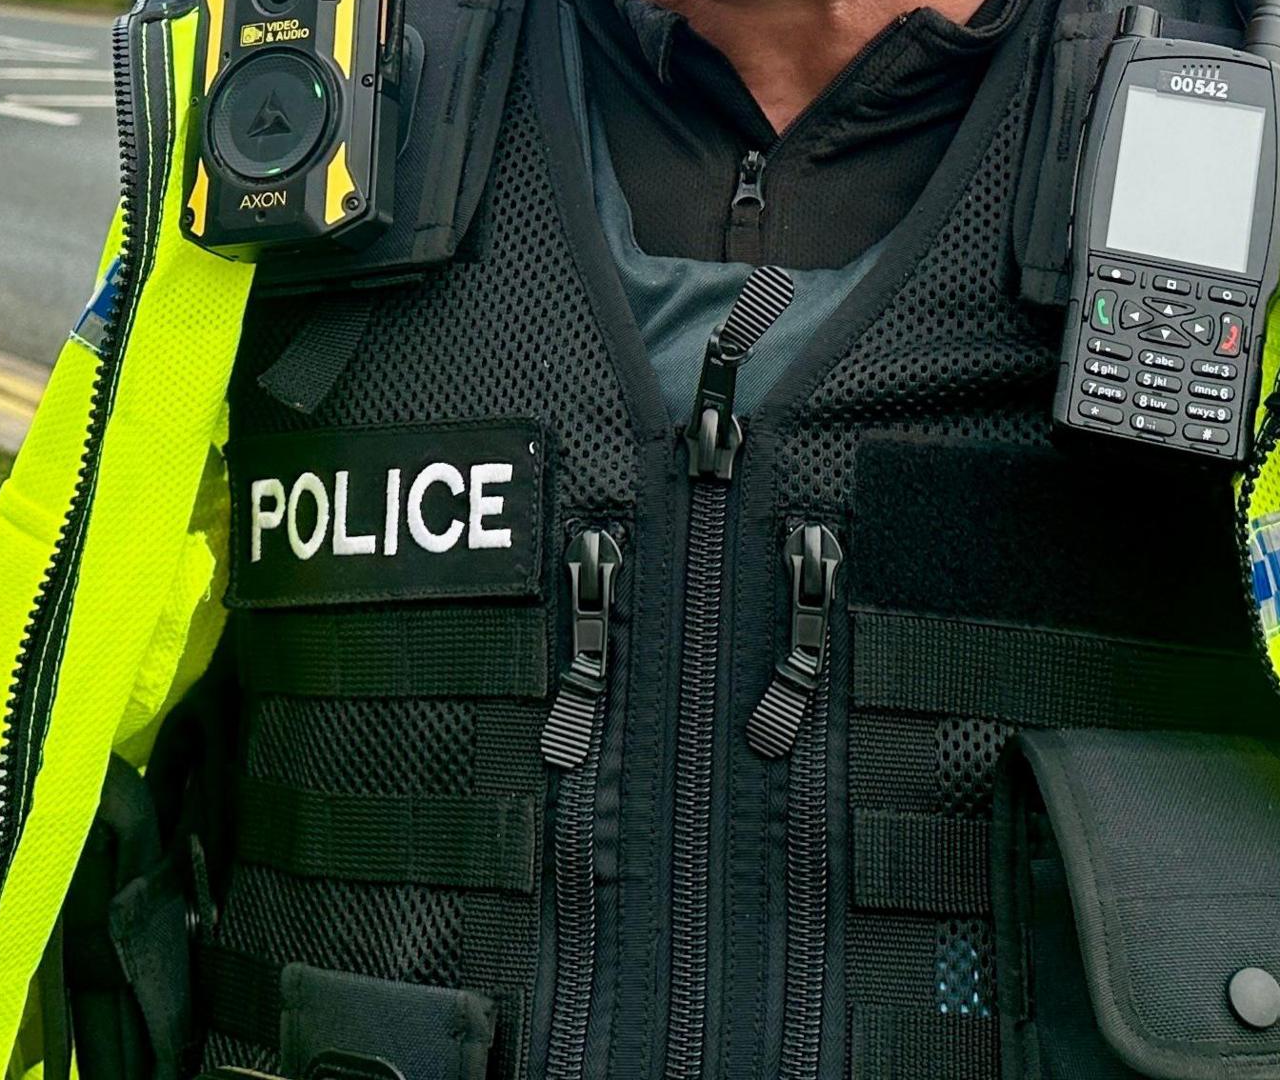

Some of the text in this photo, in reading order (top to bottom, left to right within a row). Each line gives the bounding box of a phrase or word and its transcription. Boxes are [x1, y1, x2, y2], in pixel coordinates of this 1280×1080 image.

[266, 19, 299, 32] VIDEO
[265, 27, 310, 42] & AUDIO
[1170, 75, 1229, 99] 00542
[239, 190, 287, 210] AXON
[1094, 340, 1102, 352] 1
[1145, 353, 1175, 367] 2 abc
[1090, 361, 1119, 376] 4 ghi
[1220, 365, 1230, 377] 3
[1142, 374, 1168, 388] 5 jkl
[1087, 382, 1122, 399] 7 pqrs
[1194, 384, 1229, 399] mno 6
[1139, 395, 1148, 407] 8
[1188, 405, 1227, 421] wxyz 9
[1135, 415, 1145, 428] 0
[250, 461, 514, 563] POLICE
